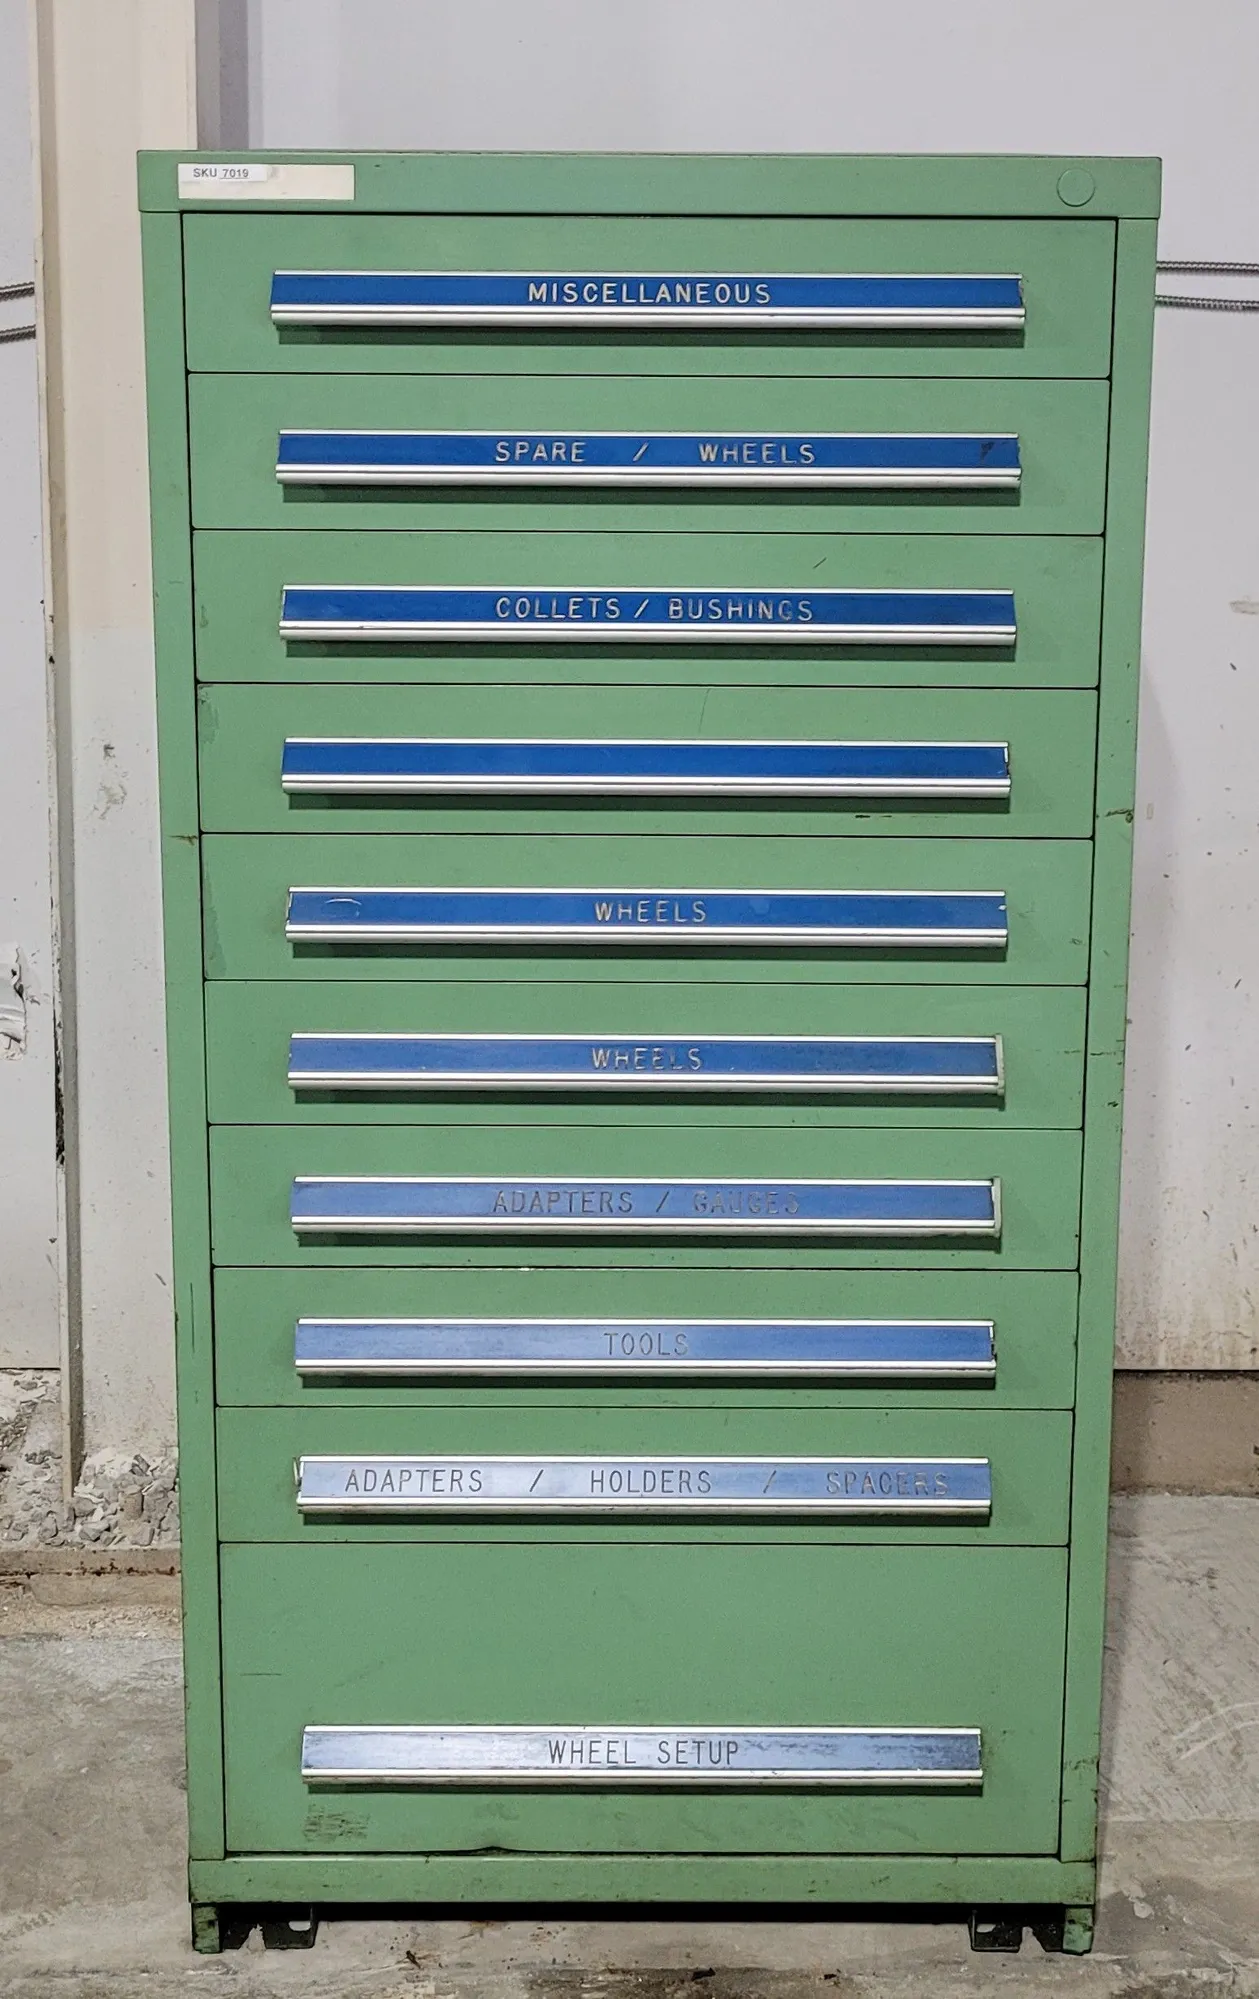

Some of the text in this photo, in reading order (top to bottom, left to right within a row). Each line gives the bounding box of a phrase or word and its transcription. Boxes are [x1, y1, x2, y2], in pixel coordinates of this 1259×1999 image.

[193, 167, 249, 178] SKU 7019
[528, 282, 771, 304] MISCELLANEOUS
[495, 441, 815, 465] SPARE / WHEELS
[496, 597, 813, 621] COLLETS / BUSHINGS
[594, 900, 706, 923] WHEELS
[592, 1047, 702, 1070] WHEELS
[492, 1190, 800, 1214] ADAPTERS / GAUGES
[603, 1332, 689, 1356] TOOLS
[345, 1469, 949, 1496] ADAPTERS / HOLDERS / SPACERS
[548, 1740, 739, 1765] WHEEL SETUP
